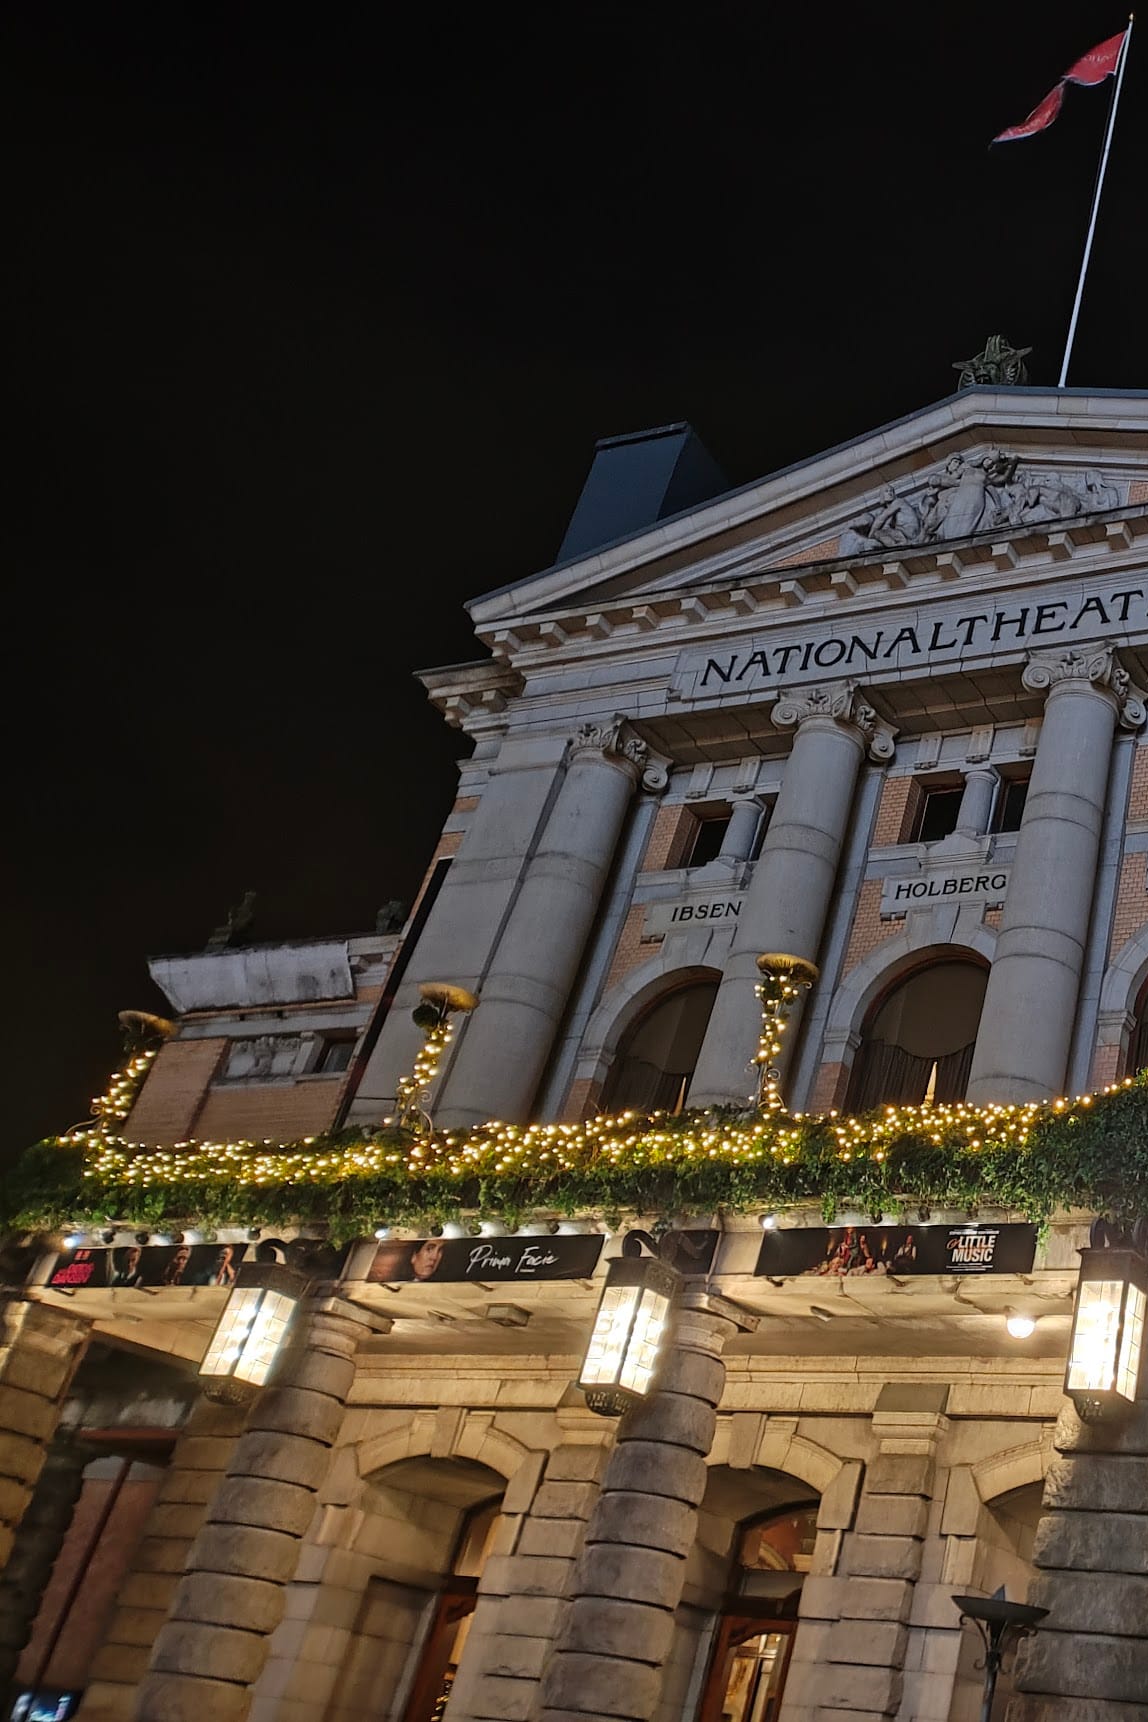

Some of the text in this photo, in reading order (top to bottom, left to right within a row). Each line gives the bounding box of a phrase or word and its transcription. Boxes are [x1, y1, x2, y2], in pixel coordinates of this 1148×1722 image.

[895, 874, 1007, 900] HOLBERG
[671, 901, 742, 922] IBSEN
[958, 1235, 997, 1248] LITTLE
[515, 1246, 560, 1273] Facie
[951, 1248, 994, 1263] MUSIC
